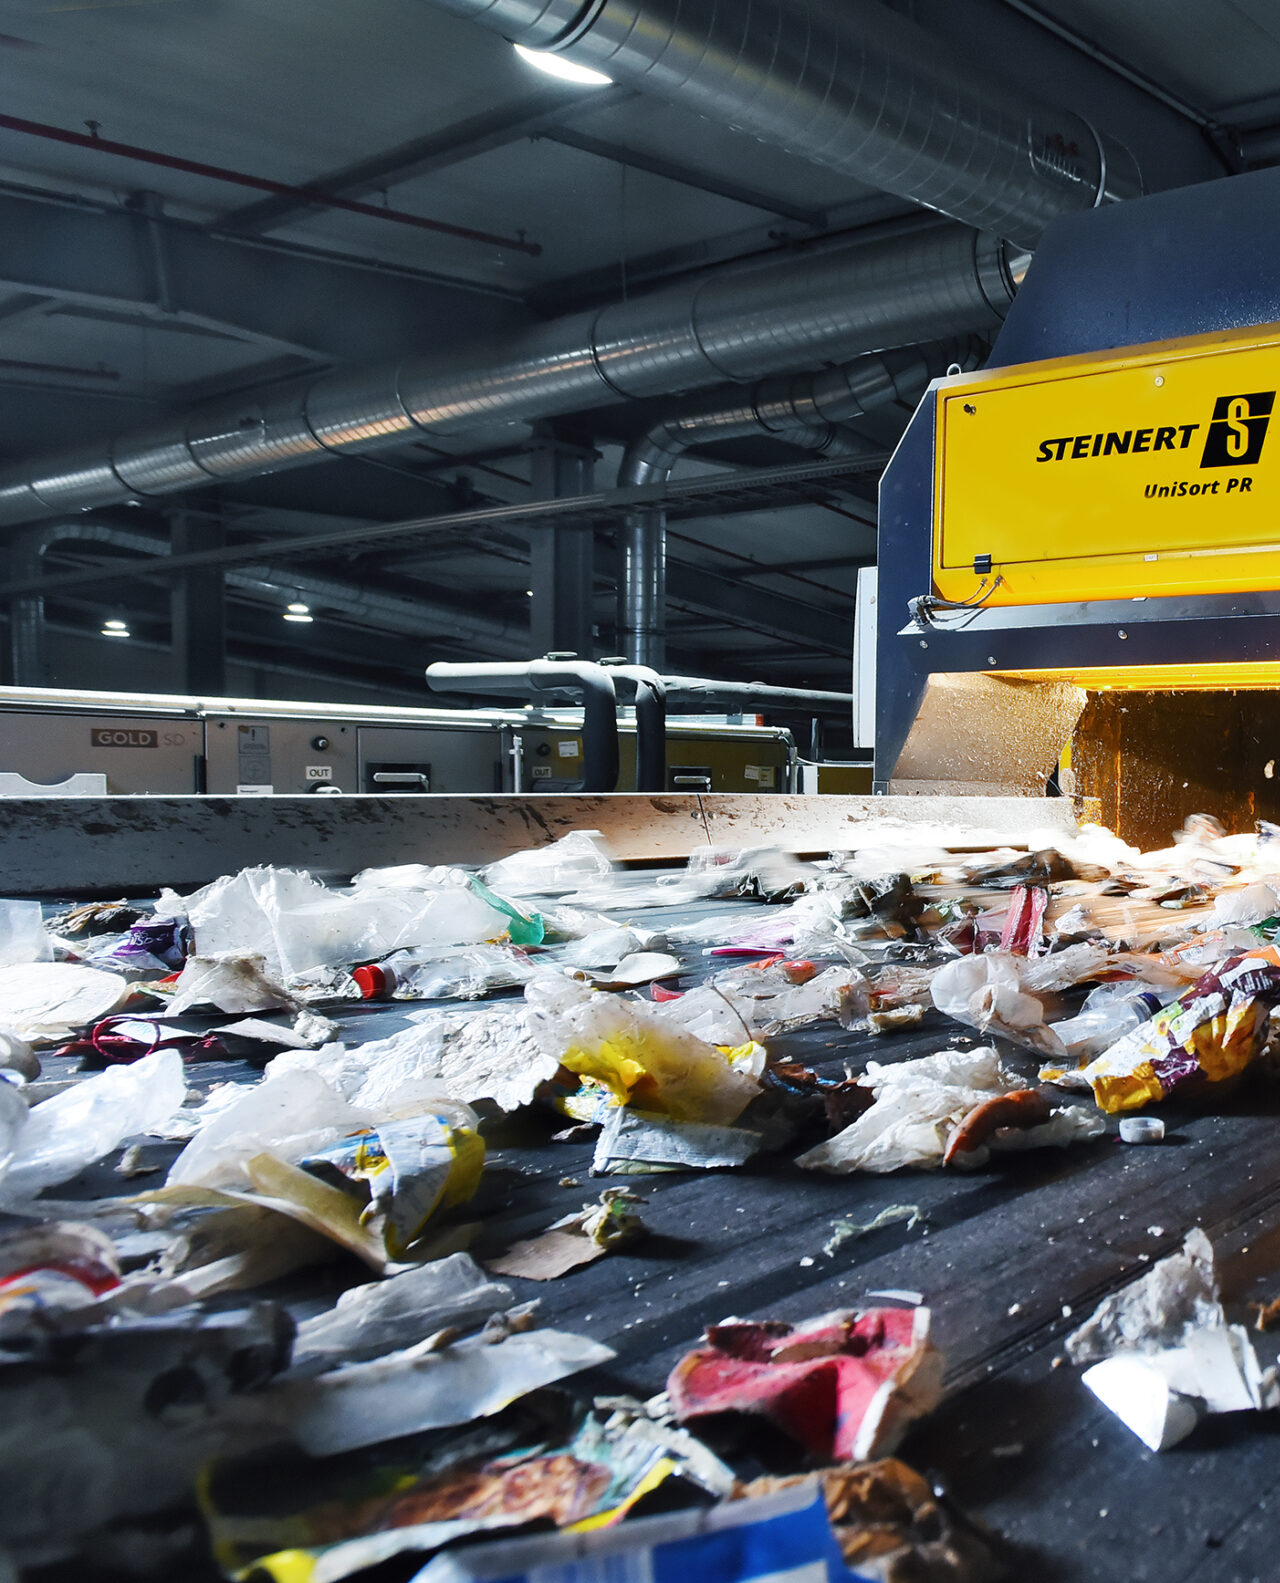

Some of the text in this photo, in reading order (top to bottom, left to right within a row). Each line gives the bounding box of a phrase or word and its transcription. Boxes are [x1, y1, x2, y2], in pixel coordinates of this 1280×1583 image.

[1036, 423, 1200, 463] STEINERT
[1144, 477, 1253, 499] UniSort PR
[98, 731, 151, 745] GOLD
[309, 768, 329, 778] OUT
[534, 768, 550, 776] OUT
